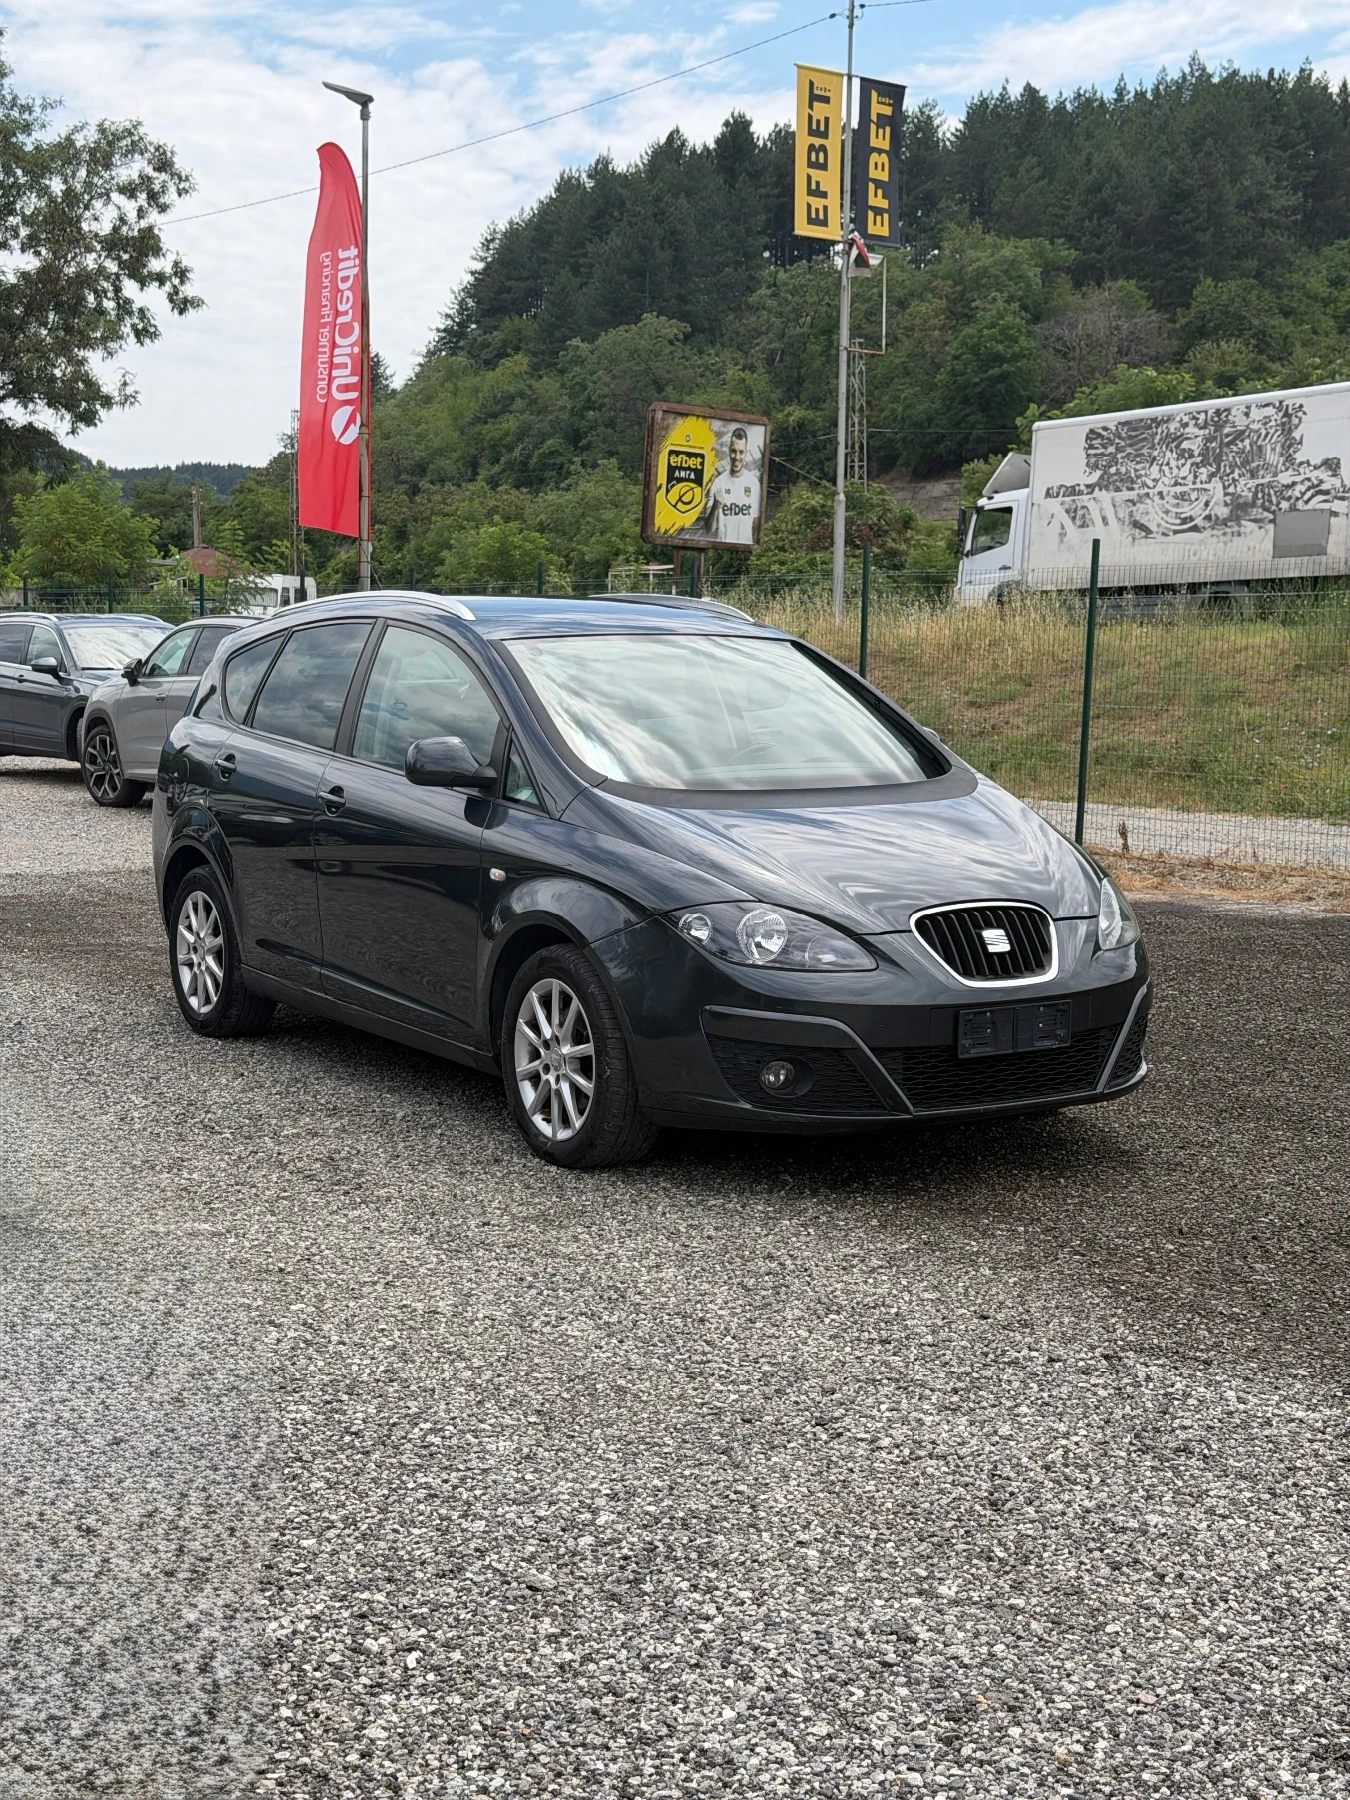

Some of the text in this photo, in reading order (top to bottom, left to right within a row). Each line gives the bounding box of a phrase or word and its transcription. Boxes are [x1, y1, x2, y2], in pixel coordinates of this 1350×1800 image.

[807, 79, 831, 228] EFBET
[867, 89, 894, 237] EFBET
[674, 470, 695, 479] ЛИГА
[722, 502, 752, 517] efbet
